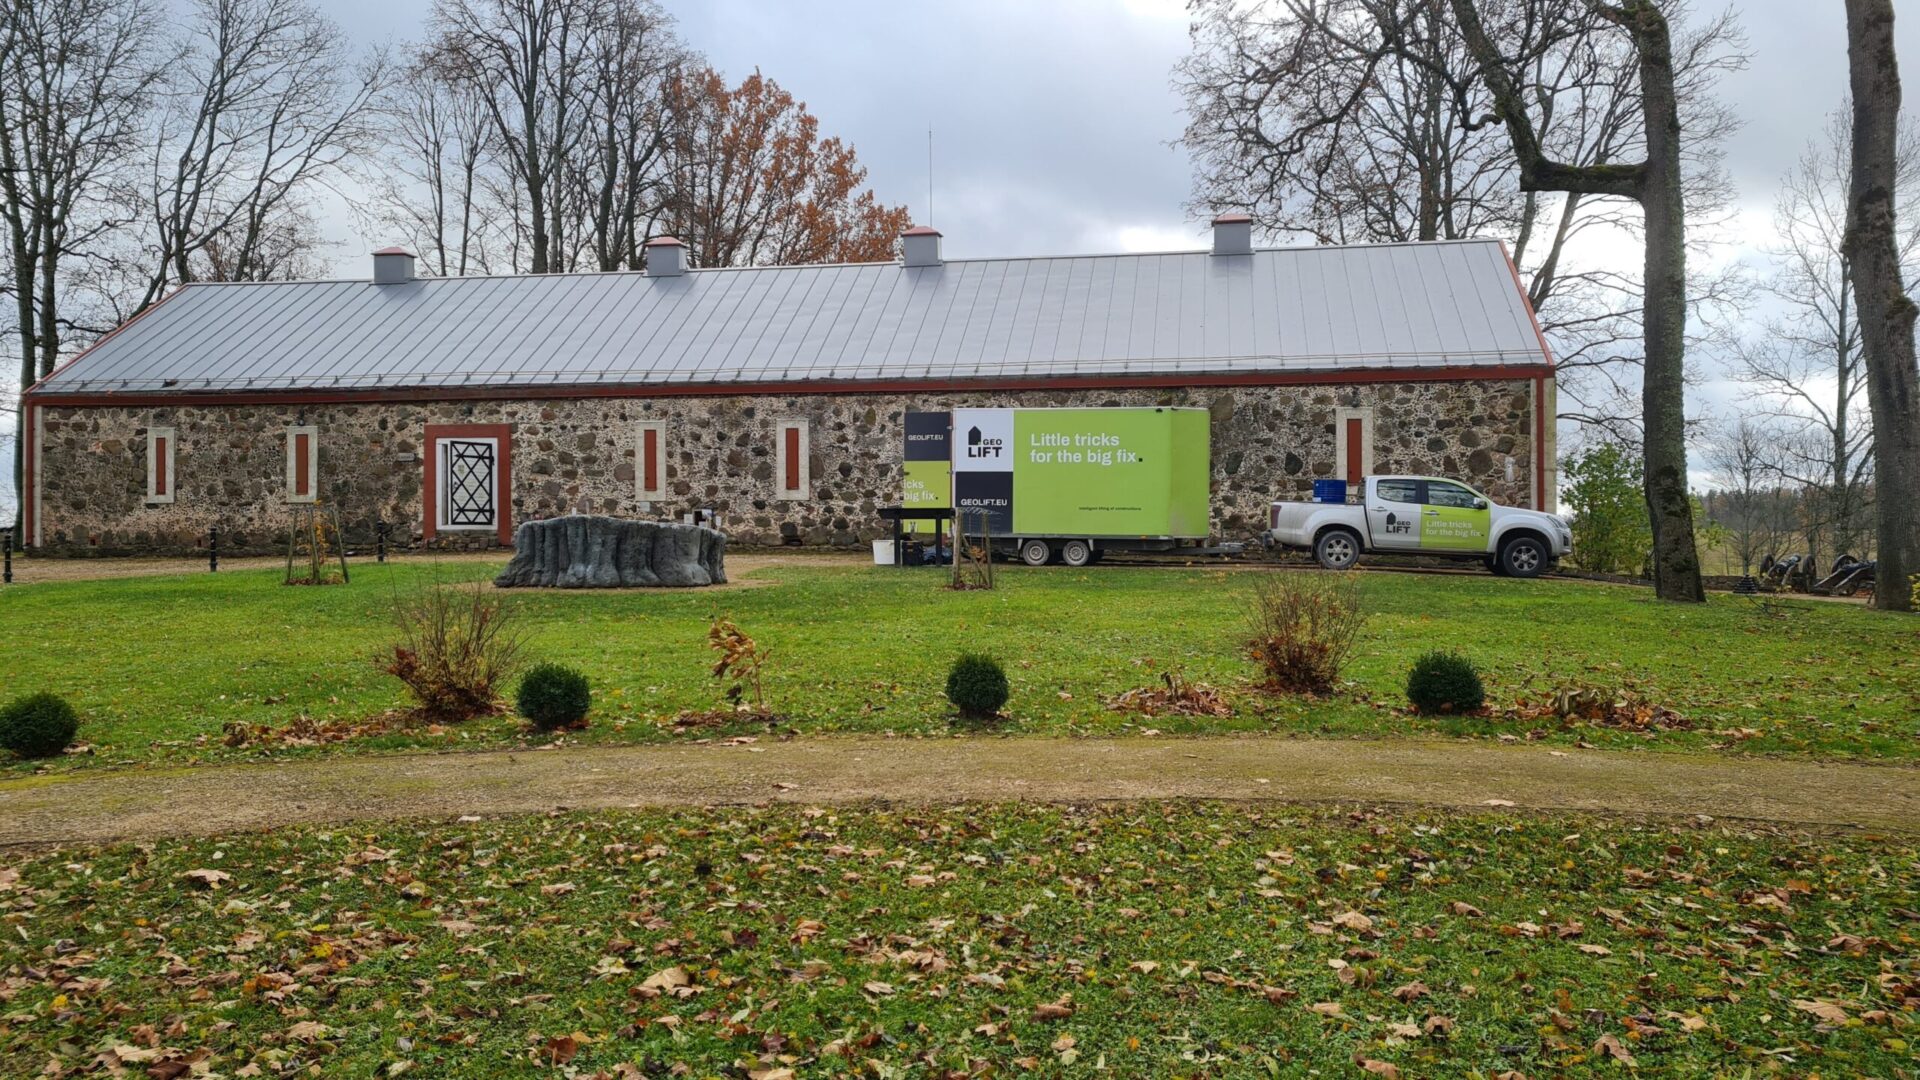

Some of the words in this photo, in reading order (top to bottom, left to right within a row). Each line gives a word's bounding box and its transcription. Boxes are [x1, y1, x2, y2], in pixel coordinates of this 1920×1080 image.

[1031, 433, 1070, 446] Little
[1074, 433, 1120, 446] tricks
[968, 447, 1002, 457] LIFT
[1030, 449, 1053, 463] for
[1057, 450, 1082, 463] the
[1087, 449, 1112, 465] big
[1116, 449, 1143, 463] fix.
[904, 491, 919, 502] big
[922, 491, 938, 500] fix.
[1426, 520, 1447, 528] Little
[1449, 521, 1472, 529] tricks
[1455, 529, 1469, 538] big
